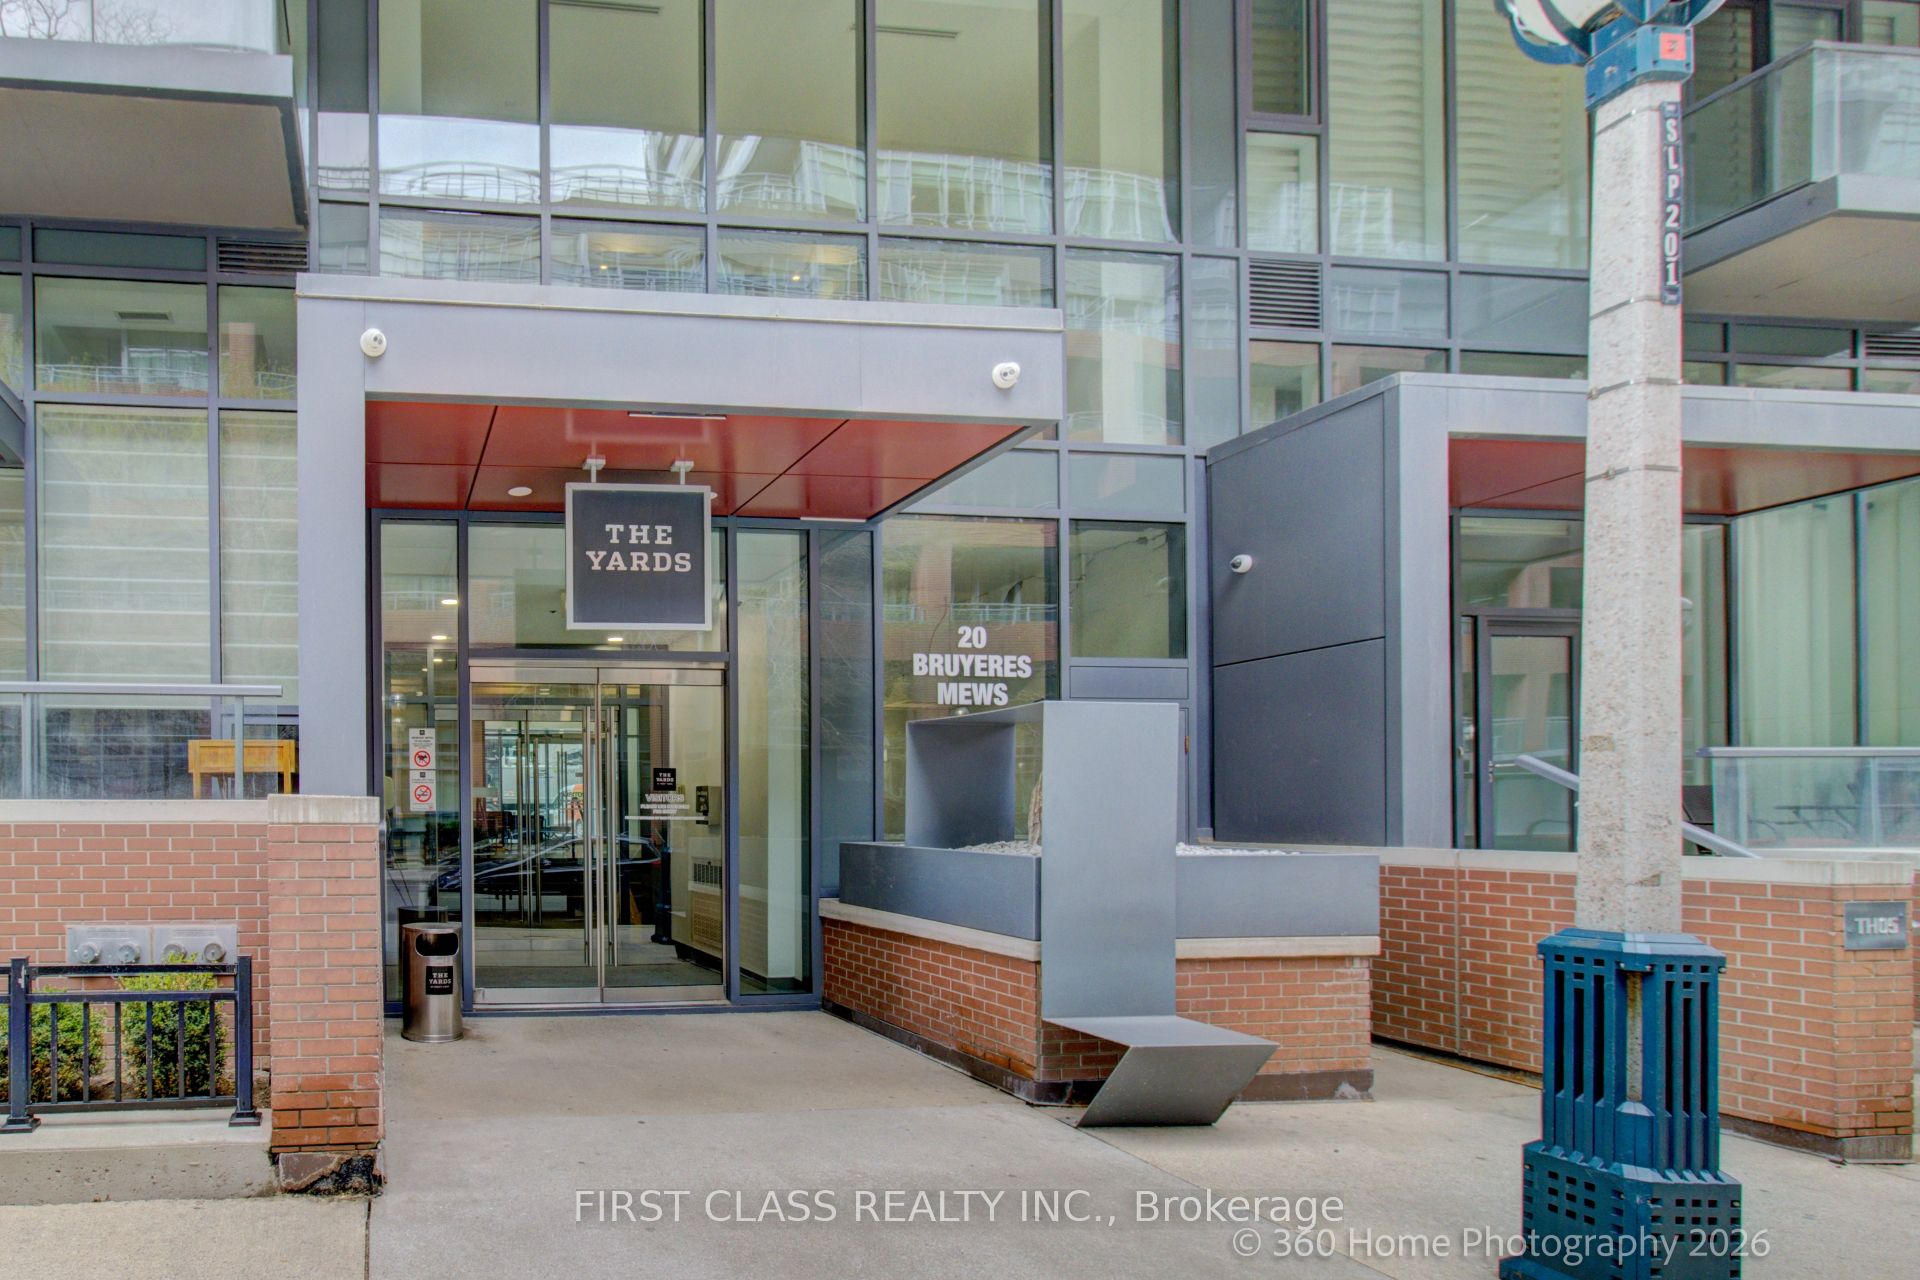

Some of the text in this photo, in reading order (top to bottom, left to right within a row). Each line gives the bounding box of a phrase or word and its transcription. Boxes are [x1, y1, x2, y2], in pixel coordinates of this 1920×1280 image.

[1663, 117, 1681, 286] SLP201
[605, 524, 673, 545] THE
[585, 550, 692, 572] YARDS
[957, 625, 987, 649] 20
[912, 653, 1032, 679] BRUYERES
[937, 682, 1009, 706] MEWS
